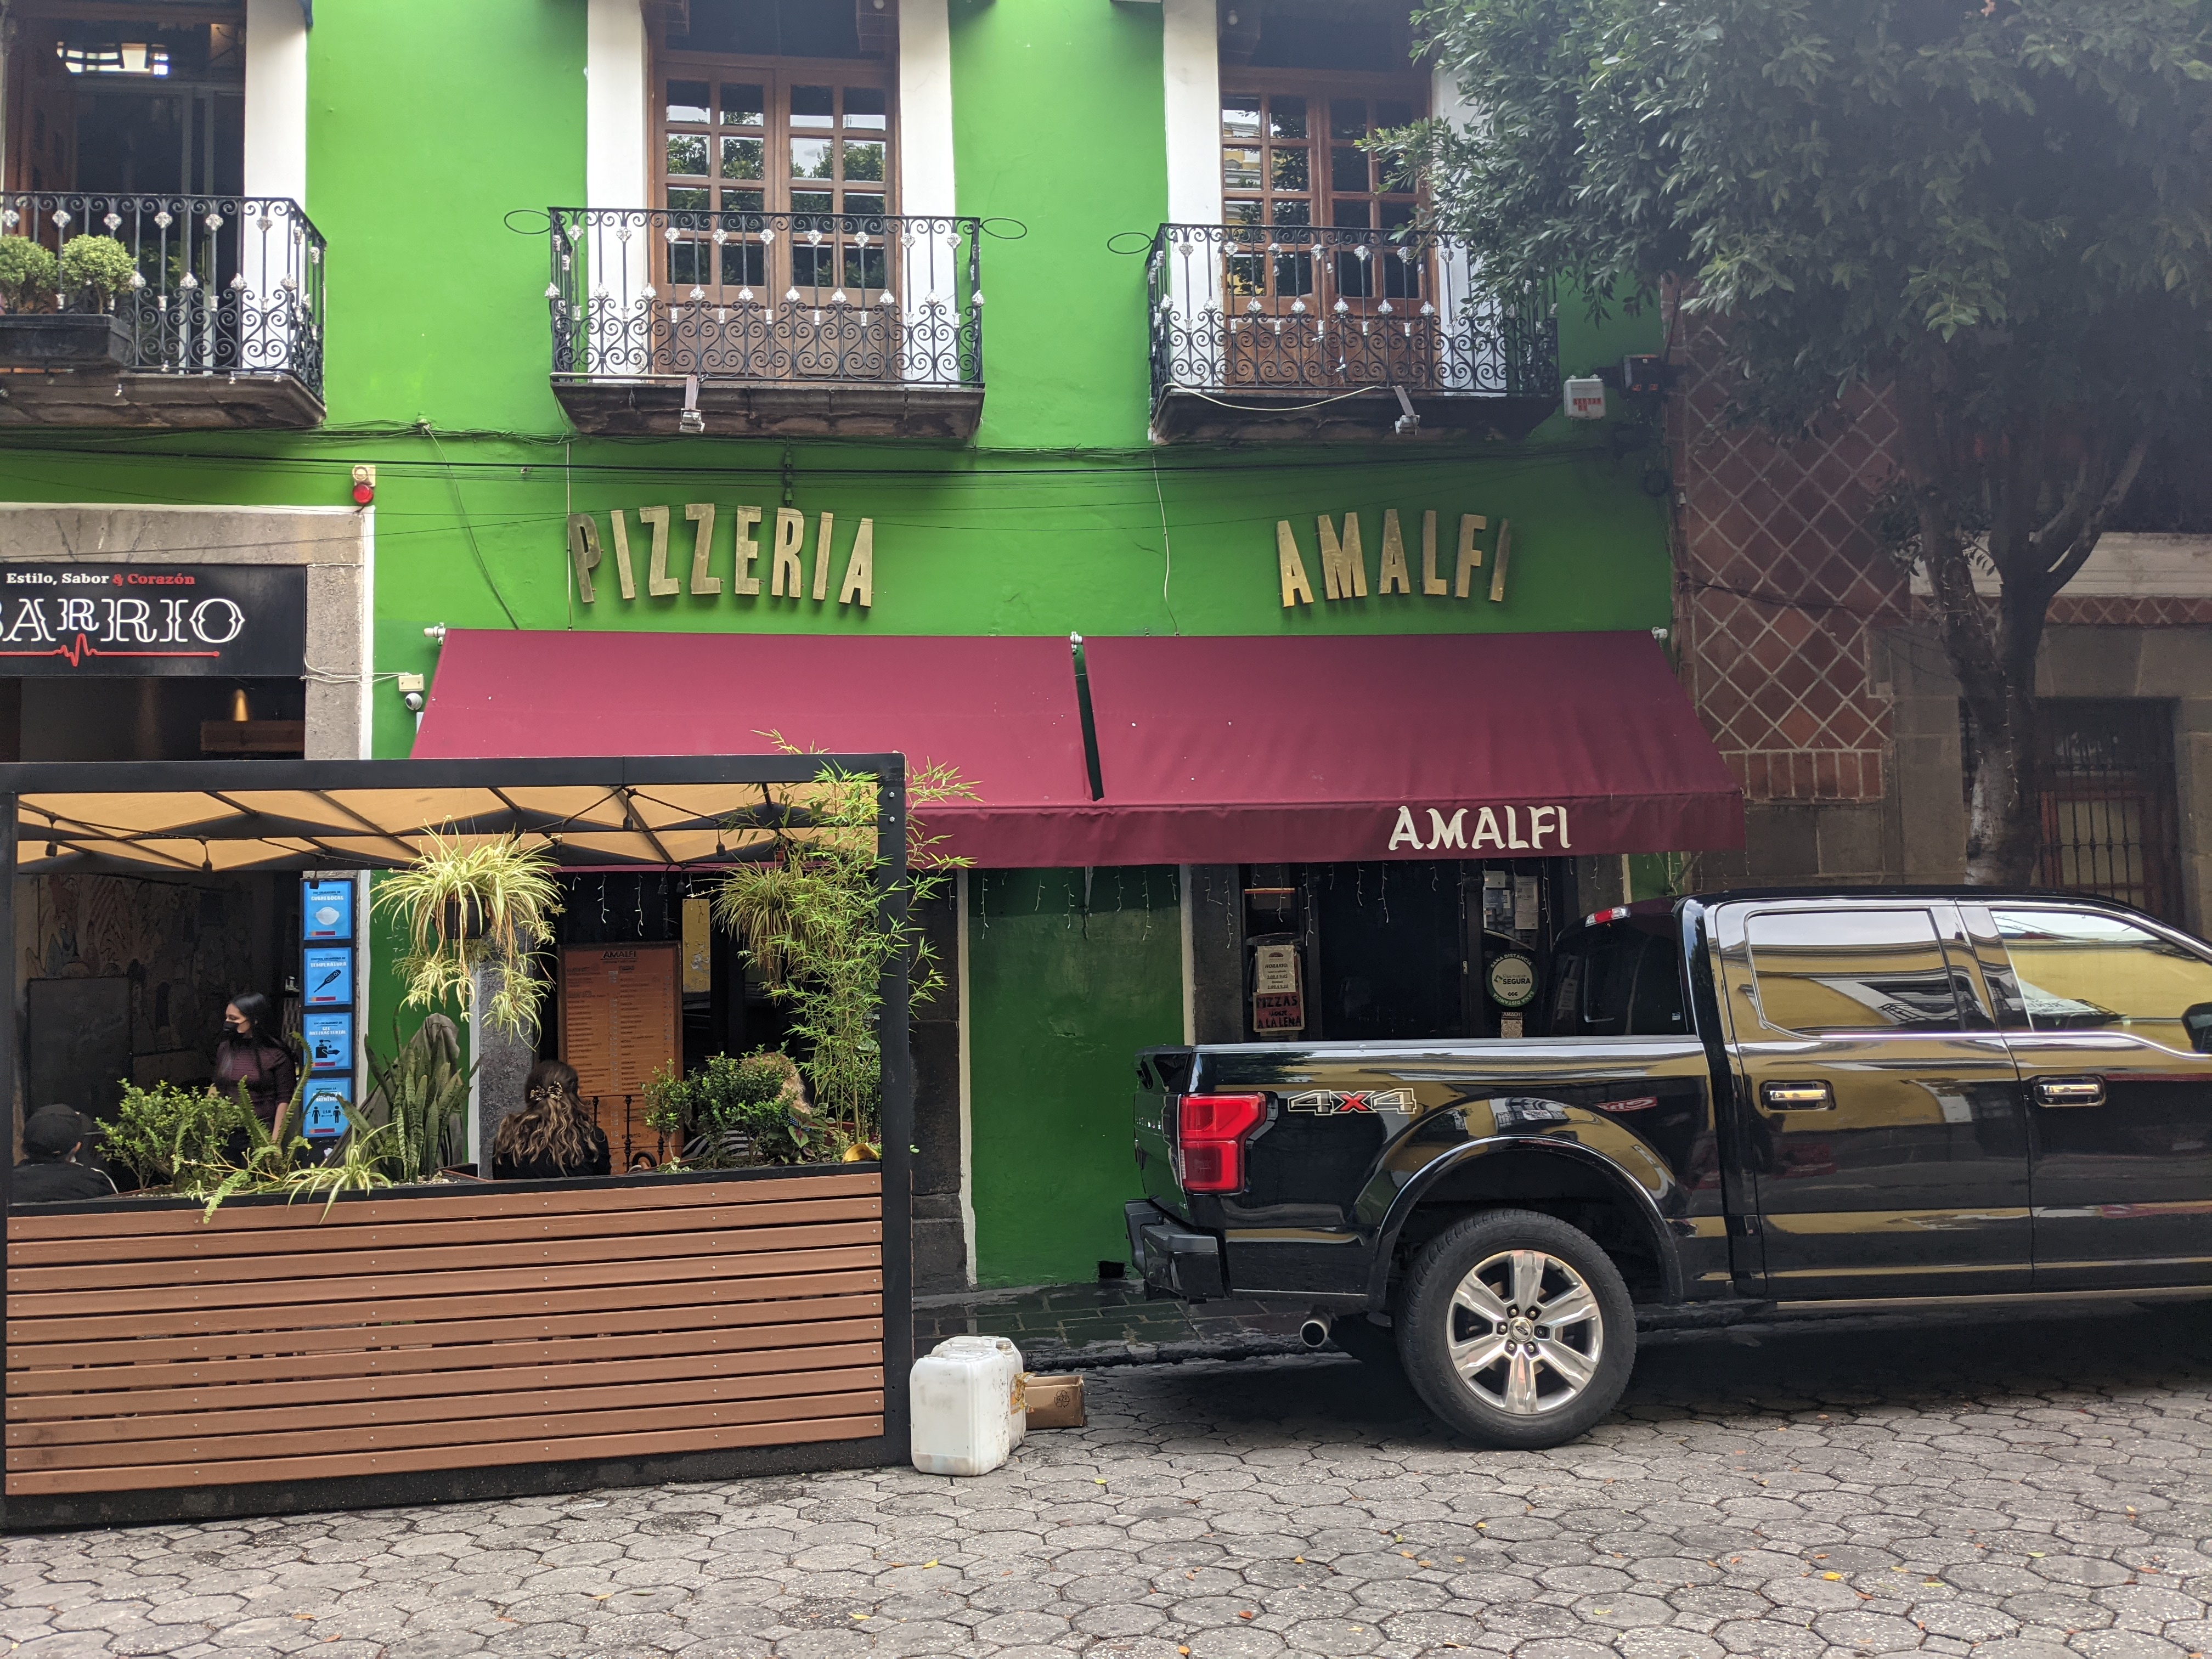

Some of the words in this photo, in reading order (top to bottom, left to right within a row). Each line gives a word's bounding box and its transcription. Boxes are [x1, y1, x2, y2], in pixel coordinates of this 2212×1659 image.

[567, 504, 873, 608] PIZZERIA
[1276, 509, 1511, 608] AMALFI
[6, 573, 58, 585] Estilo,
[61, 573, 110, 585] Sabor
[112, 574, 124, 586] &
[127, 573, 195, 585] Corazón
[0, 598, 245, 644] ARRIO
[1388, 805, 1572, 850] AMALFI
[1491, 956, 1503, 968] SANA
[1504, 953, 1532, 966] DISTANCIA
[1256, 995, 1298, 1008] PIZZAS
